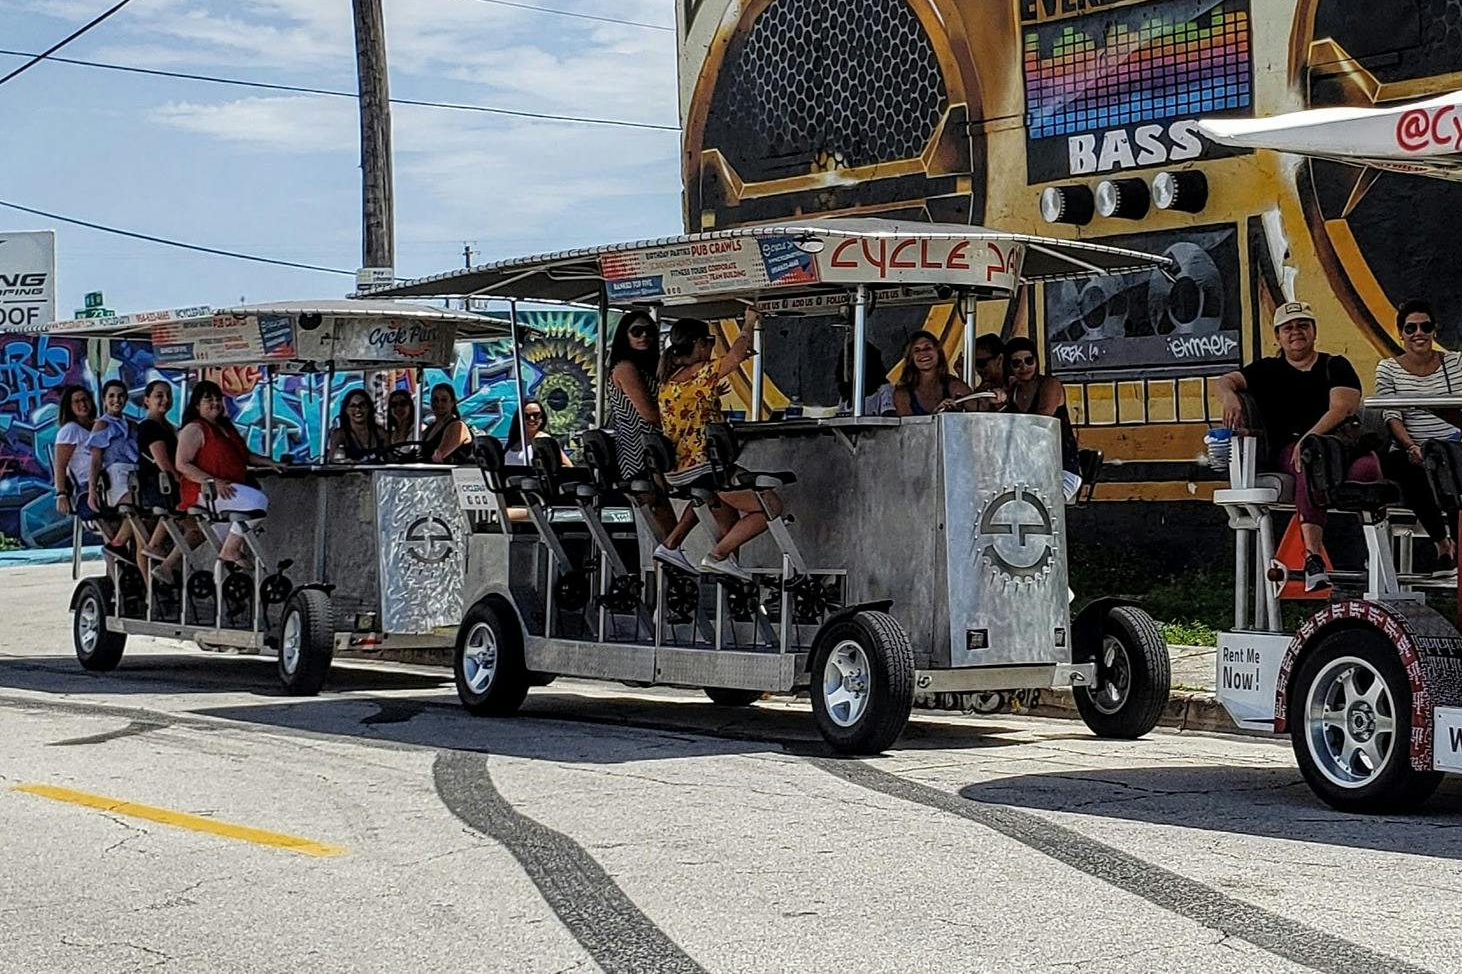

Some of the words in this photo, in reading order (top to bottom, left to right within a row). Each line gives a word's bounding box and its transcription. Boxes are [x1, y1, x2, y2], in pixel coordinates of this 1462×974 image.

[1068, 119, 1202, 175] BASS
[691, 243, 708, 257] PUB
[709, 239, 742, 254] CRAWLS
[831, 238, 970, 278] CYCLE
[0, 288, 43, 296] FING
[369, 327, 407, 348] Cycle
[1222, 646, 1244, 663] Rent
[1246, 648, 1260, 664] Me
[1222, 666, 1260, 691] Now!
